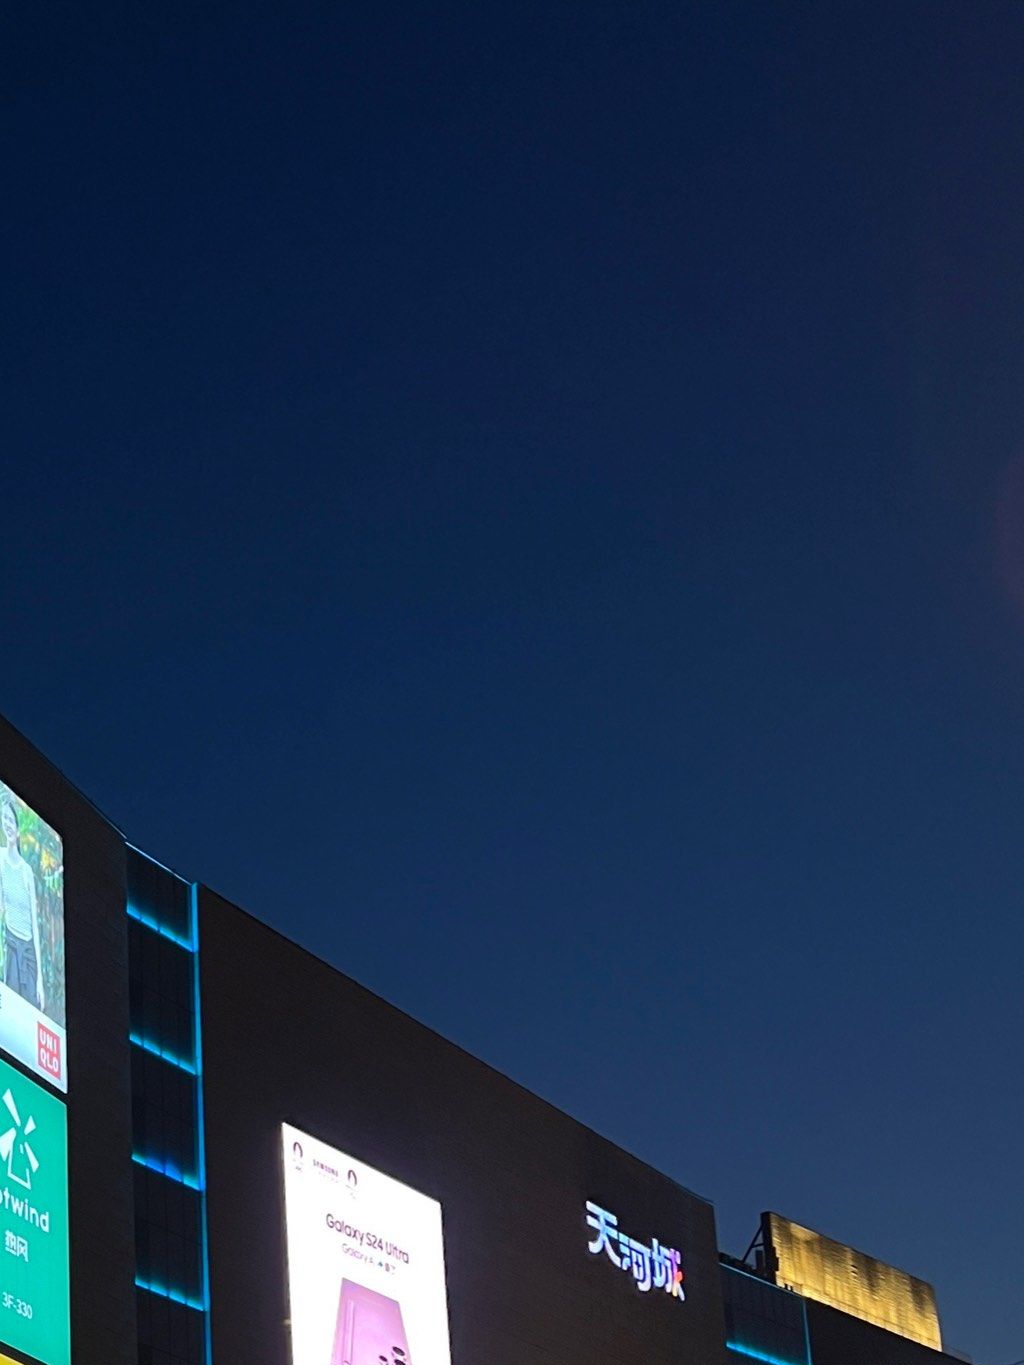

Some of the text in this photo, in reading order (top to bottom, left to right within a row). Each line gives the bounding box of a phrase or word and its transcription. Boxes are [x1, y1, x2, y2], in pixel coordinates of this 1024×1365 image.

[39, 1028, 57, 1055] UNI
[40, 1047, 60, 1073] QLO
[326, 1212, 410, 1265] Galaxy S24 Ultra
[585, 1200, 686, 1302] 天河城
[2, 1291, 33, 1320] 3F-330
